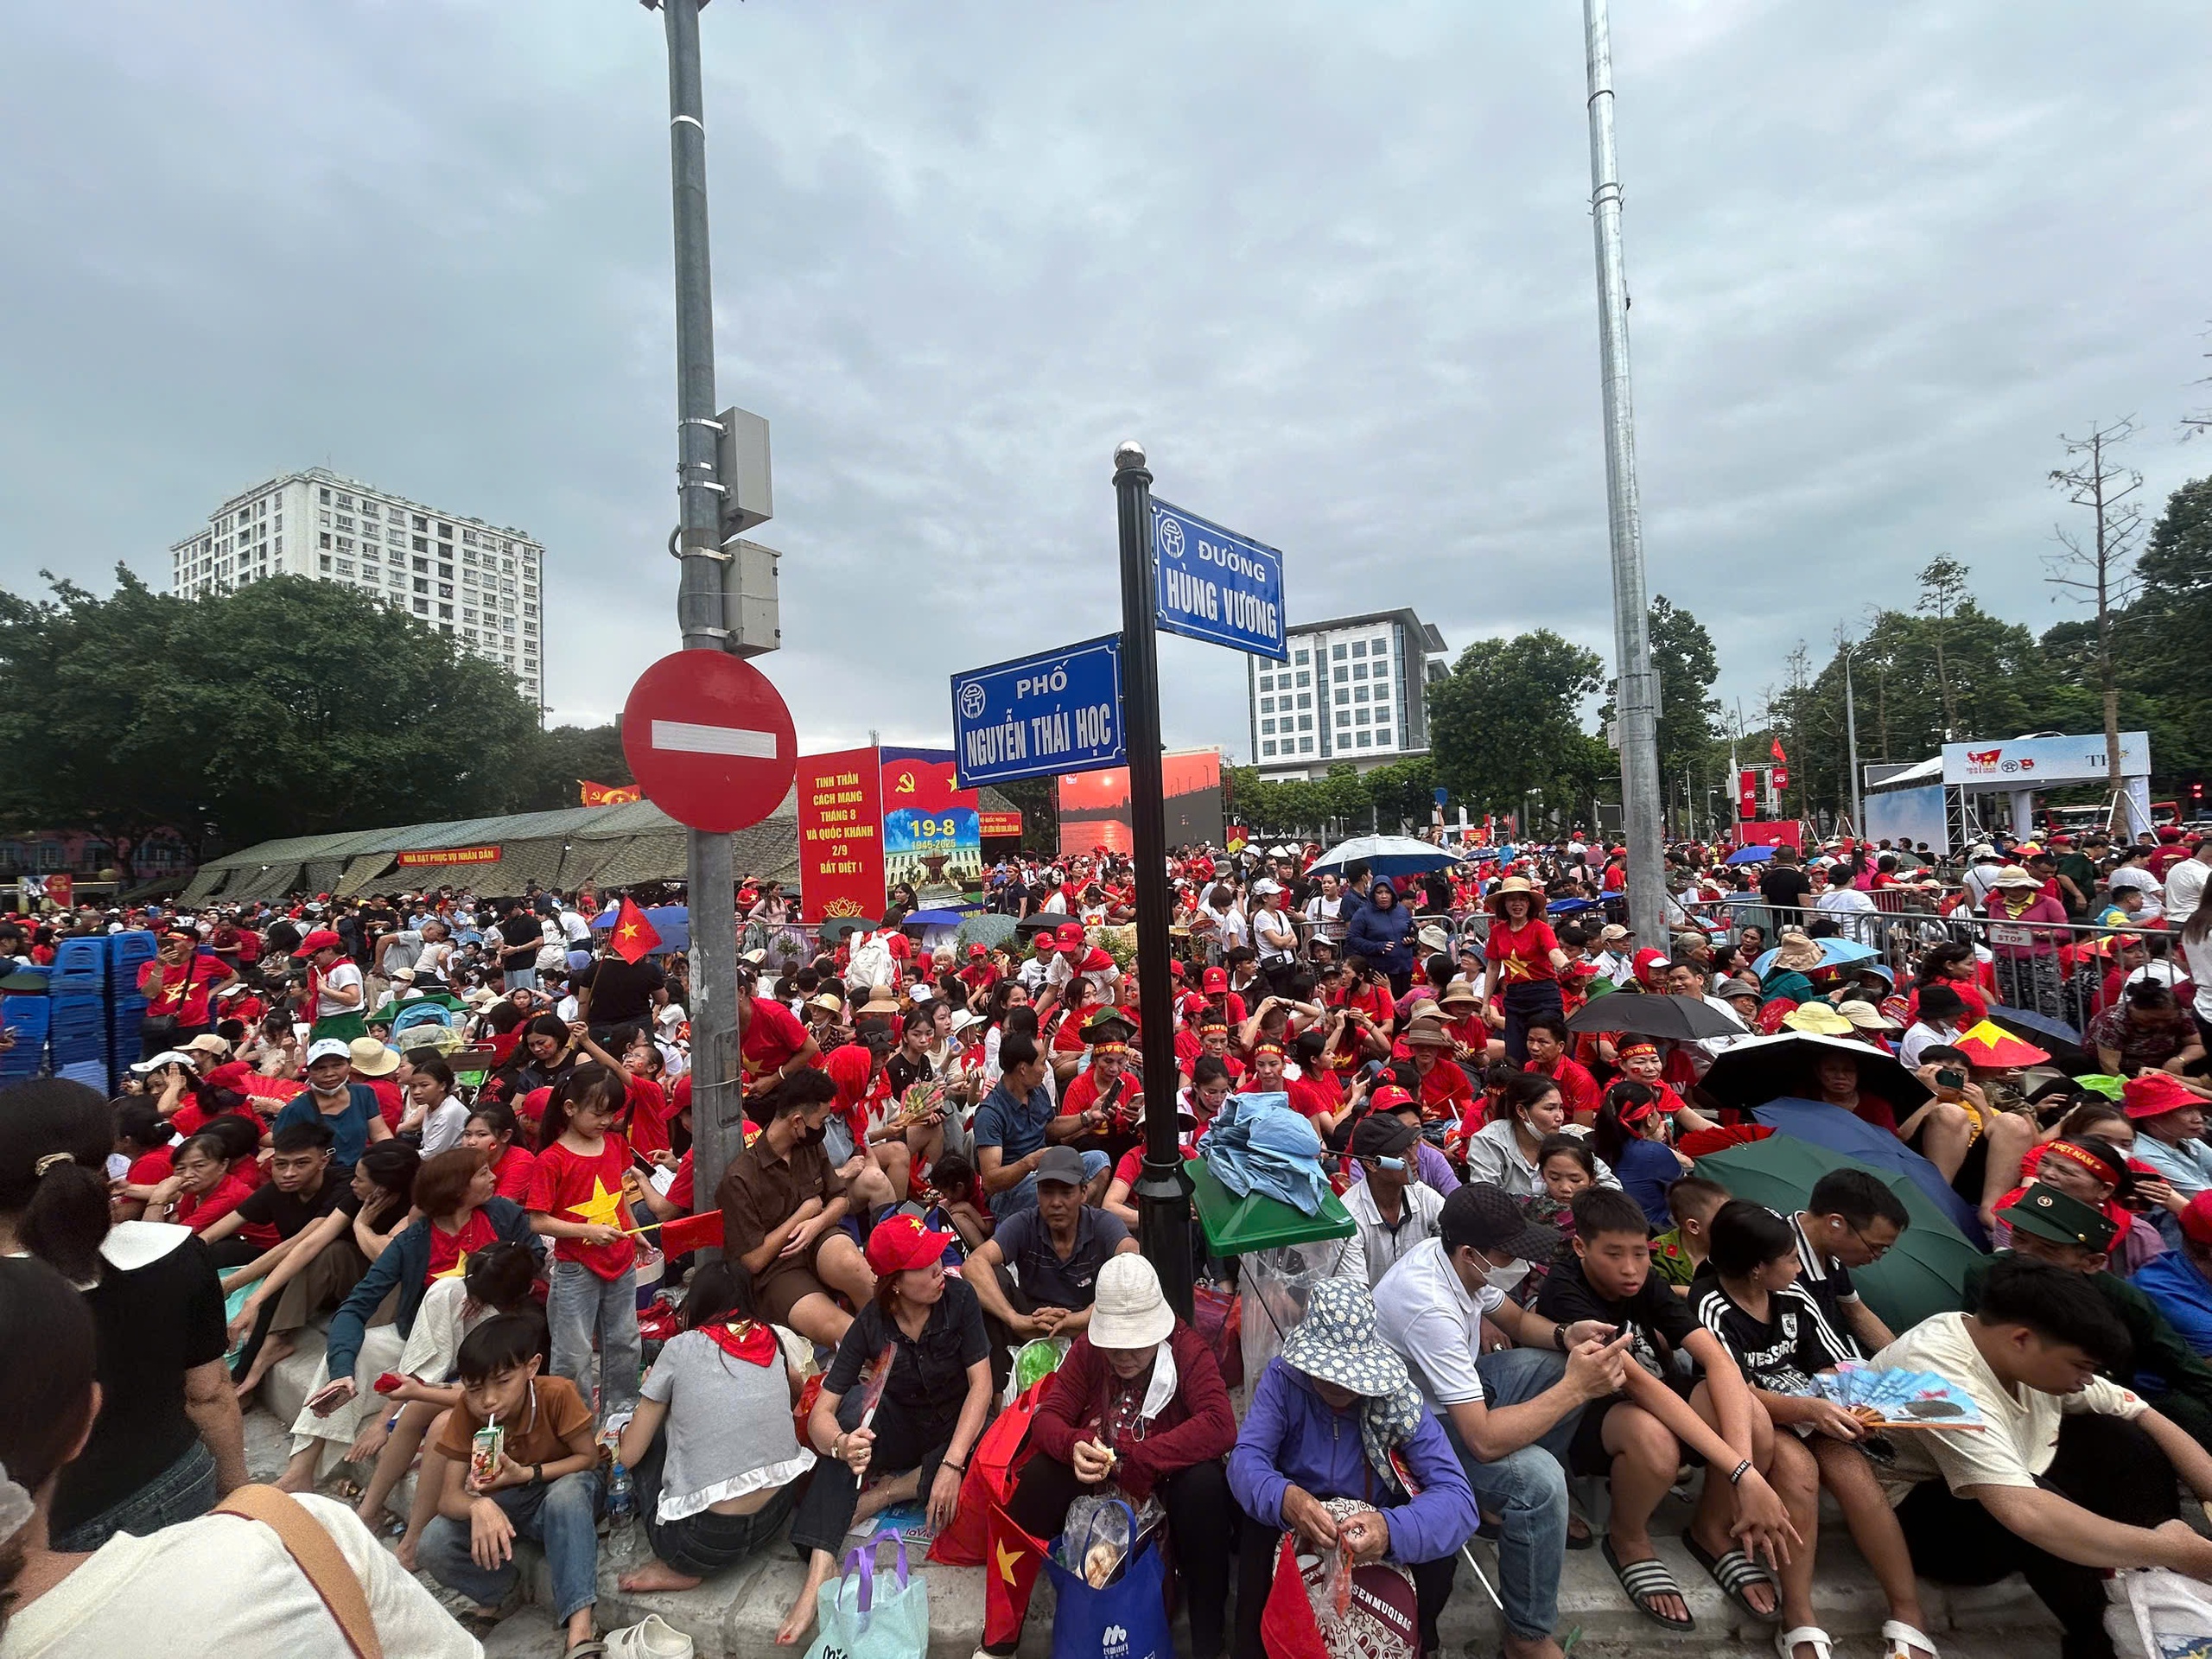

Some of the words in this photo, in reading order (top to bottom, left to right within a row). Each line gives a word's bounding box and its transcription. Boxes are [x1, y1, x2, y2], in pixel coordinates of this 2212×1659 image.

[1198, 540, 1265, 582] ĐƯỜNG
[1166, 563, 1217, 621] HÙNG
[1223, 588, 1277, 639] VƯƠNG
[1016, 660, 1068, 699] PHỐ
[966, 709, 1027, 767] NGUYỄN
[1032, 704, 1070, 756] THÁI
[1076, 703, 1111, 756] HỌC
[815, 776, 835, 788] TINH
[836, 771, 859, 785] THẦN
[813, 793, 836, 805] CÁCH
[837, 791, 862, 804] MẠNG
[820, 810, 849, 823] THÁNG
[849, 809, 856, 820] 8
[806, 828, 817, 840] VÀ
[819, 824, 842, 841] QUỐC
[843, 824, 874, 838] KHÁNH
[911, 819, 956, 837] 19-8
[831, 844, 848, 856] 2/9
[820, 859, 836, 874] BẤT
[838, 861, 856, 875] DIỆT
[1351, 1584, 1413, 1631] SENMUQIBAG
